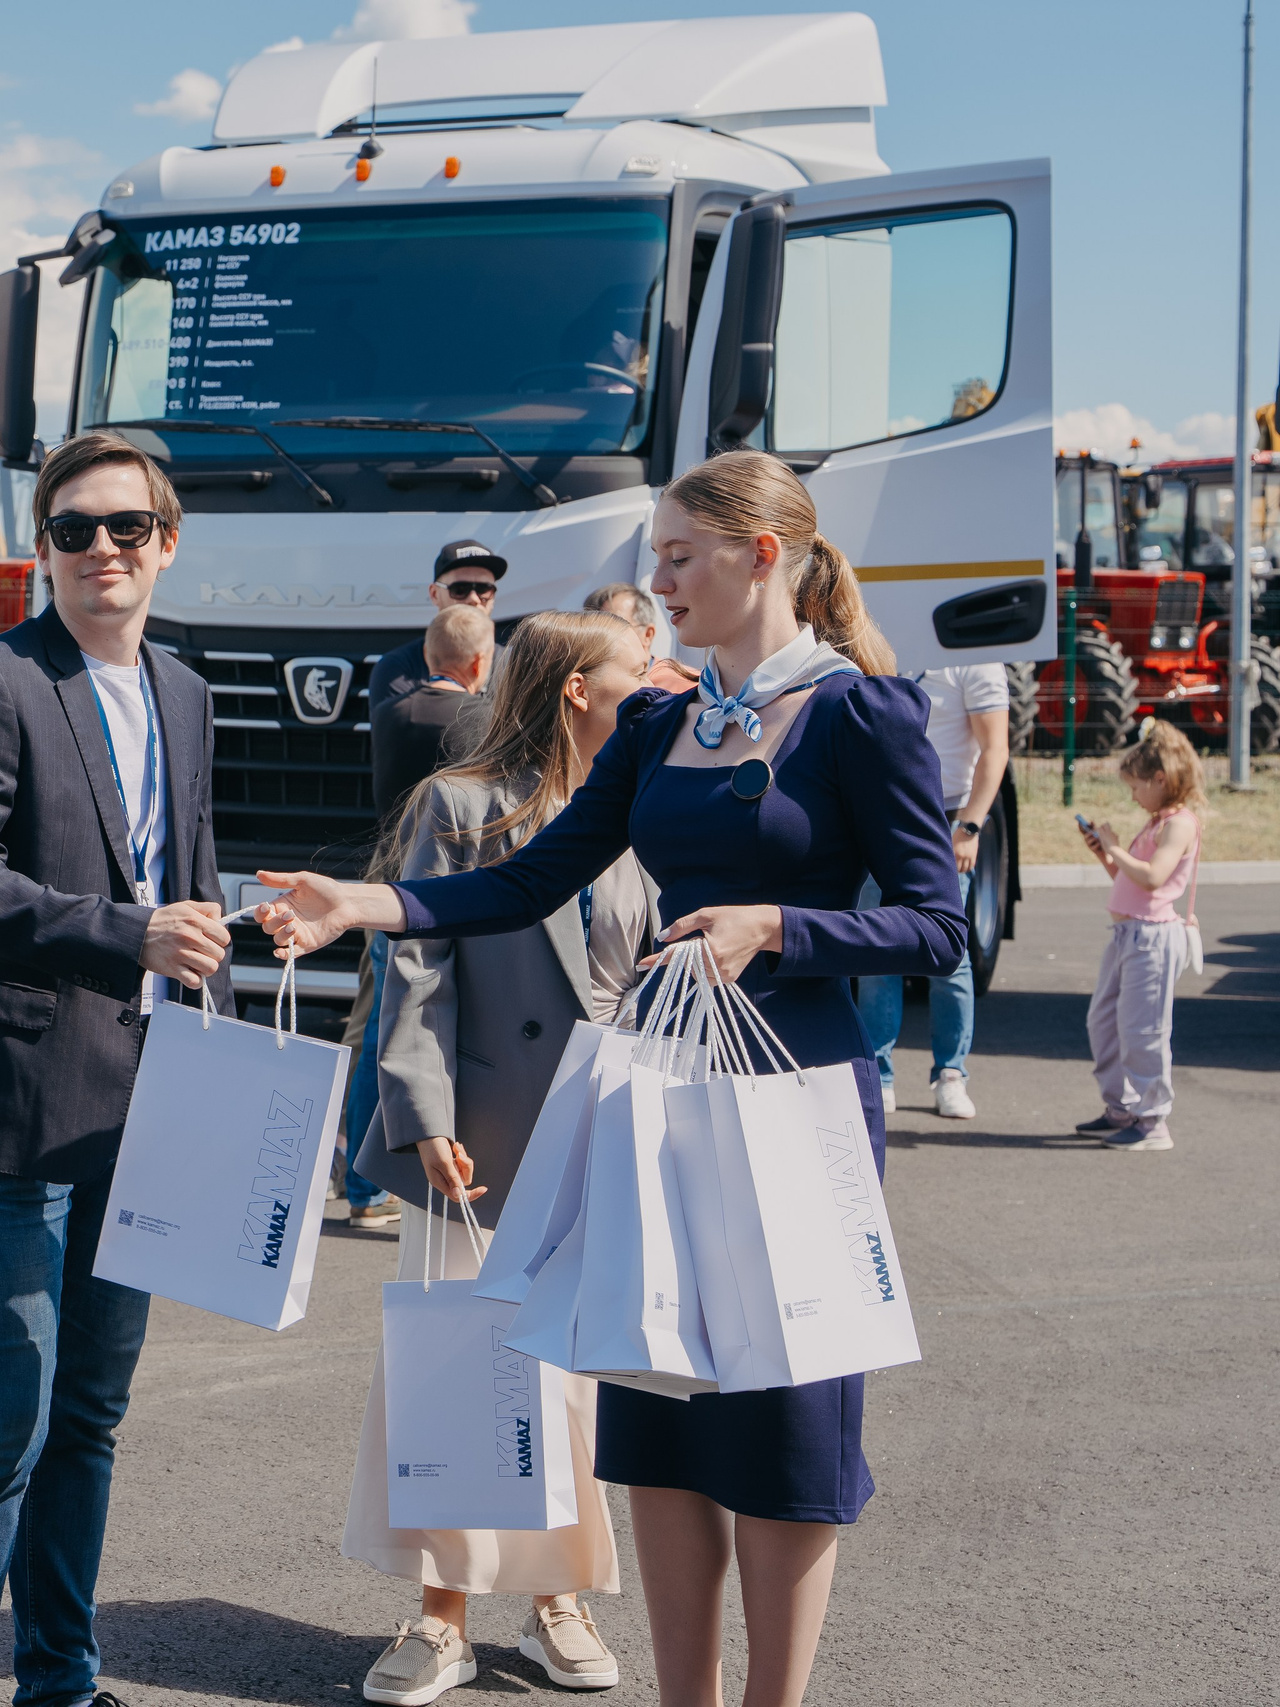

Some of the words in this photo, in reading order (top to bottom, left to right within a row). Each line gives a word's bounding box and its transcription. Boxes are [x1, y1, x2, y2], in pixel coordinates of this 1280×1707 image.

[144, 226, 225, 253] КАМАЗ
[229, 222, 301, 246] 54902
[236, 1089, 314, 1265] KAMAZ
[261, 1201, 291, 1269] KAMAZ
[815, 1121, 884, 1306] KAMAZ
[867, 1231, 896, 1302] KAMAZ
[519, 1417, 533, 1477] KAMAZ
